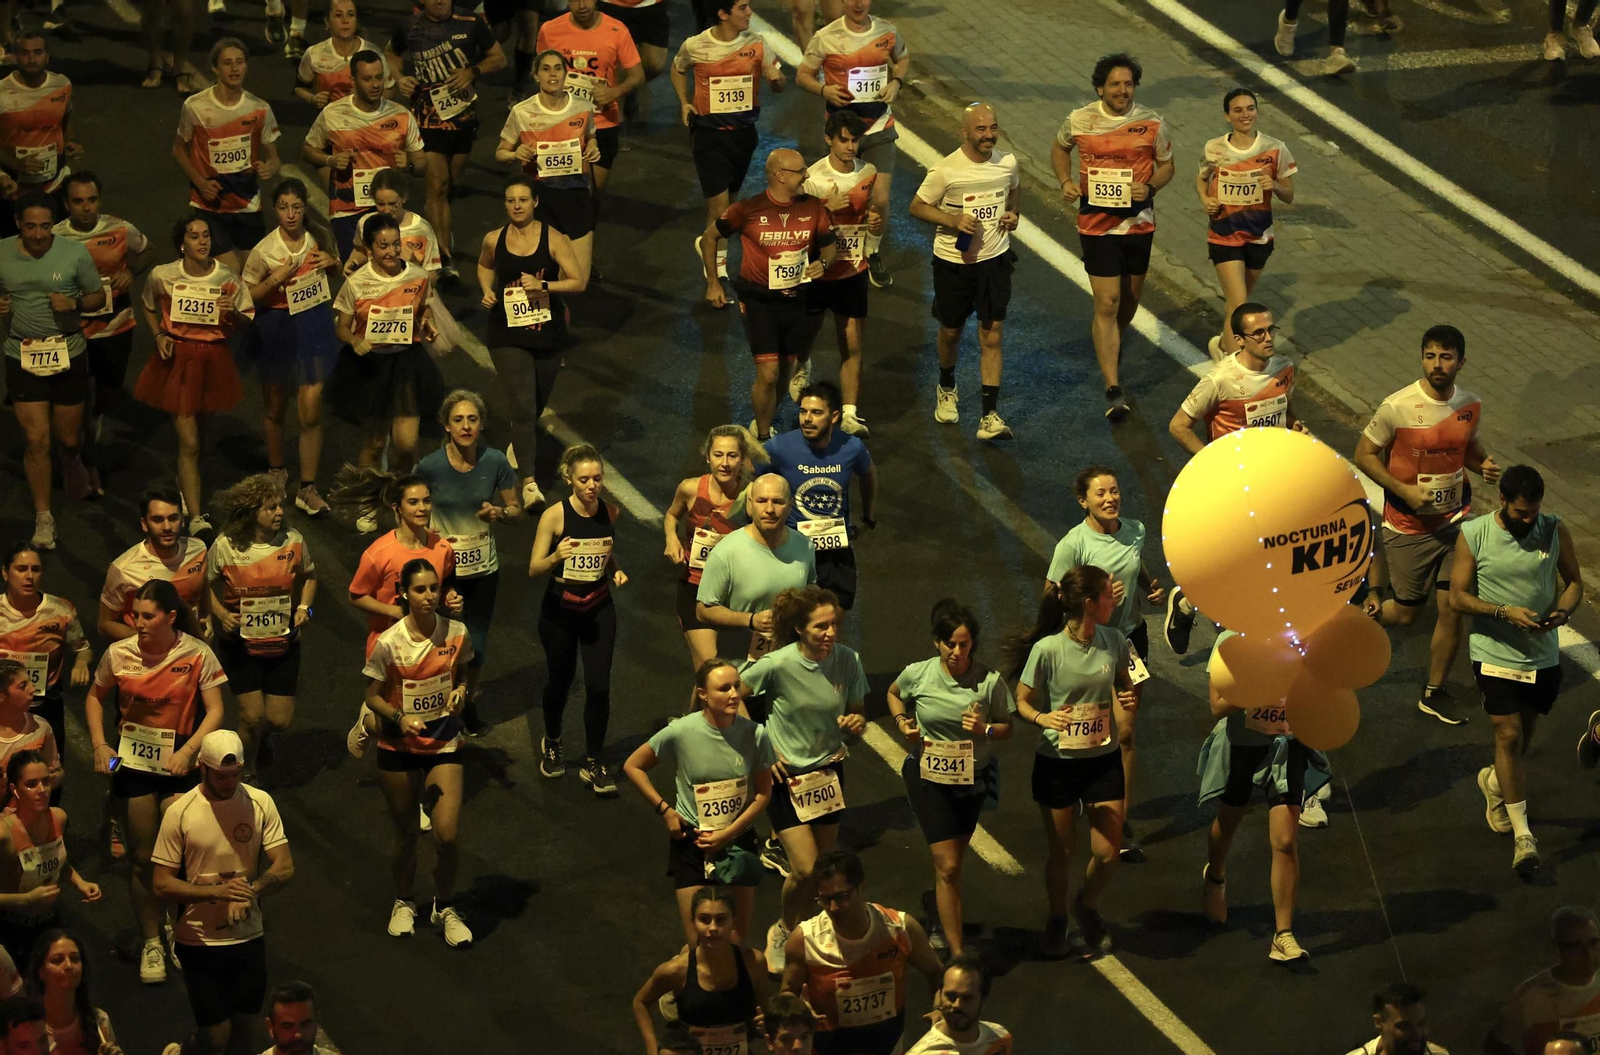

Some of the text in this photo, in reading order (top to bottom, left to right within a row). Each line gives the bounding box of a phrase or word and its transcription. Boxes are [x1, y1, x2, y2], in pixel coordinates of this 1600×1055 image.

[856, 81, 881, 93] 3116
[438, 90, 469, 111] 24310
[719, 91, 745, 103] 3139
[214, 149, 247, 164] 22903
[546, 155, 573, 167] 6545
[1095, 183, 1122, 197] 5336
[1222, 184, 1257, 196] 17707
[759, 230, 811, 241] ISBILYA
[774, 262, 805, 279] 15927
[292, 282, 323, 304] 22681
[178, 299, 214, 314] 12315
[513, 300, 541, 316] 9041
[372, 322, 407, 333] 22276
[30, 351, 59, 365] 7774
[802, 464, 841, 475] Sabadell
[1264, 517, 1347, 549] NOCTURNA
[571, 555, 607, 569] 13387
[246, 613, 283, 628] 21611
[413, 692, 444, 711] 6628
[1066, 719, 1103, 737] 17846
[131, 742, 161, 761] 1231
[926, 756, 965, 772] 12341
[797, 785, 836, 809] 17500
[703, 797, 742, 817] 23699
[37, 857, 60, 877] 7809
[843, 991, 887, 1014] 23737
